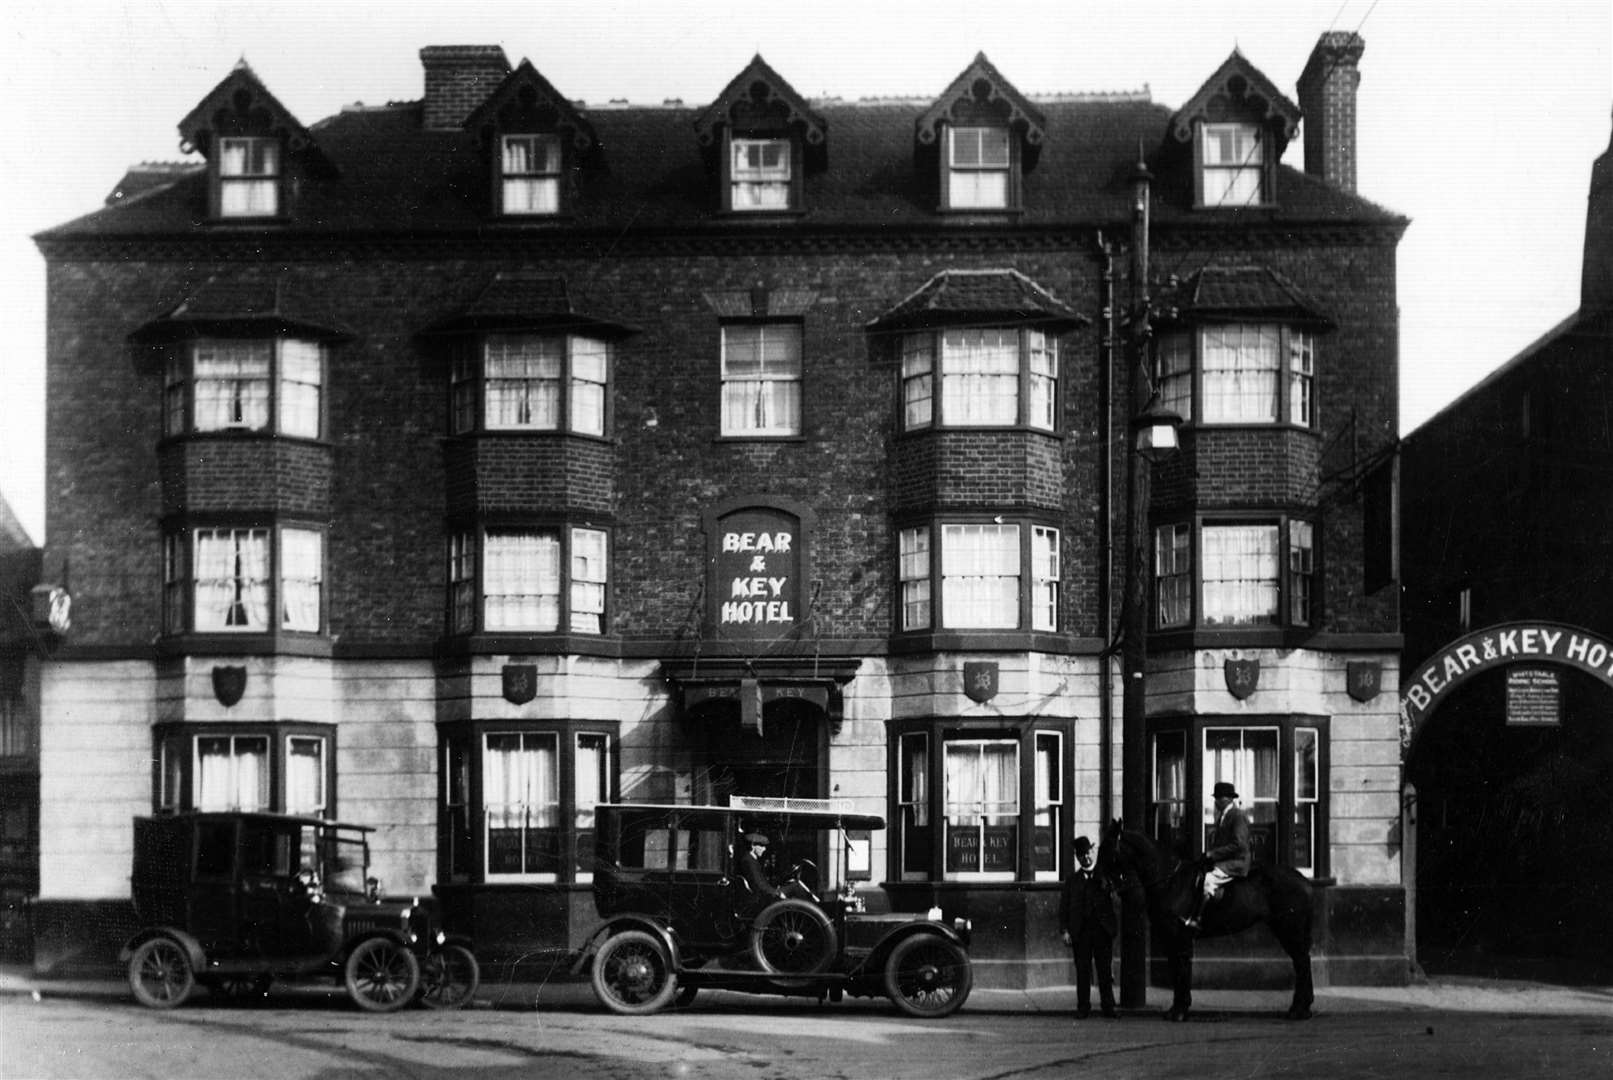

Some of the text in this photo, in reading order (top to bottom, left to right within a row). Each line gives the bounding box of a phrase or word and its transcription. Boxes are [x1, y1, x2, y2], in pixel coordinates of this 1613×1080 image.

[722, 532, 792, 553] BEAR
[750, 555, 766, 572] &
[731, 577, 787, 599] KEY
[721, 601, 794, 624] HOTEL
[1407, 643, 1482, 711] BEAR
[1482, 636, 1499, 660] &
[1499, 629, 1562, 656] KEY
[776, 687, 805, 698] KEY
[990, 836, 1009, 848] KEY
[961, 853, 1002, 864] HOEL
